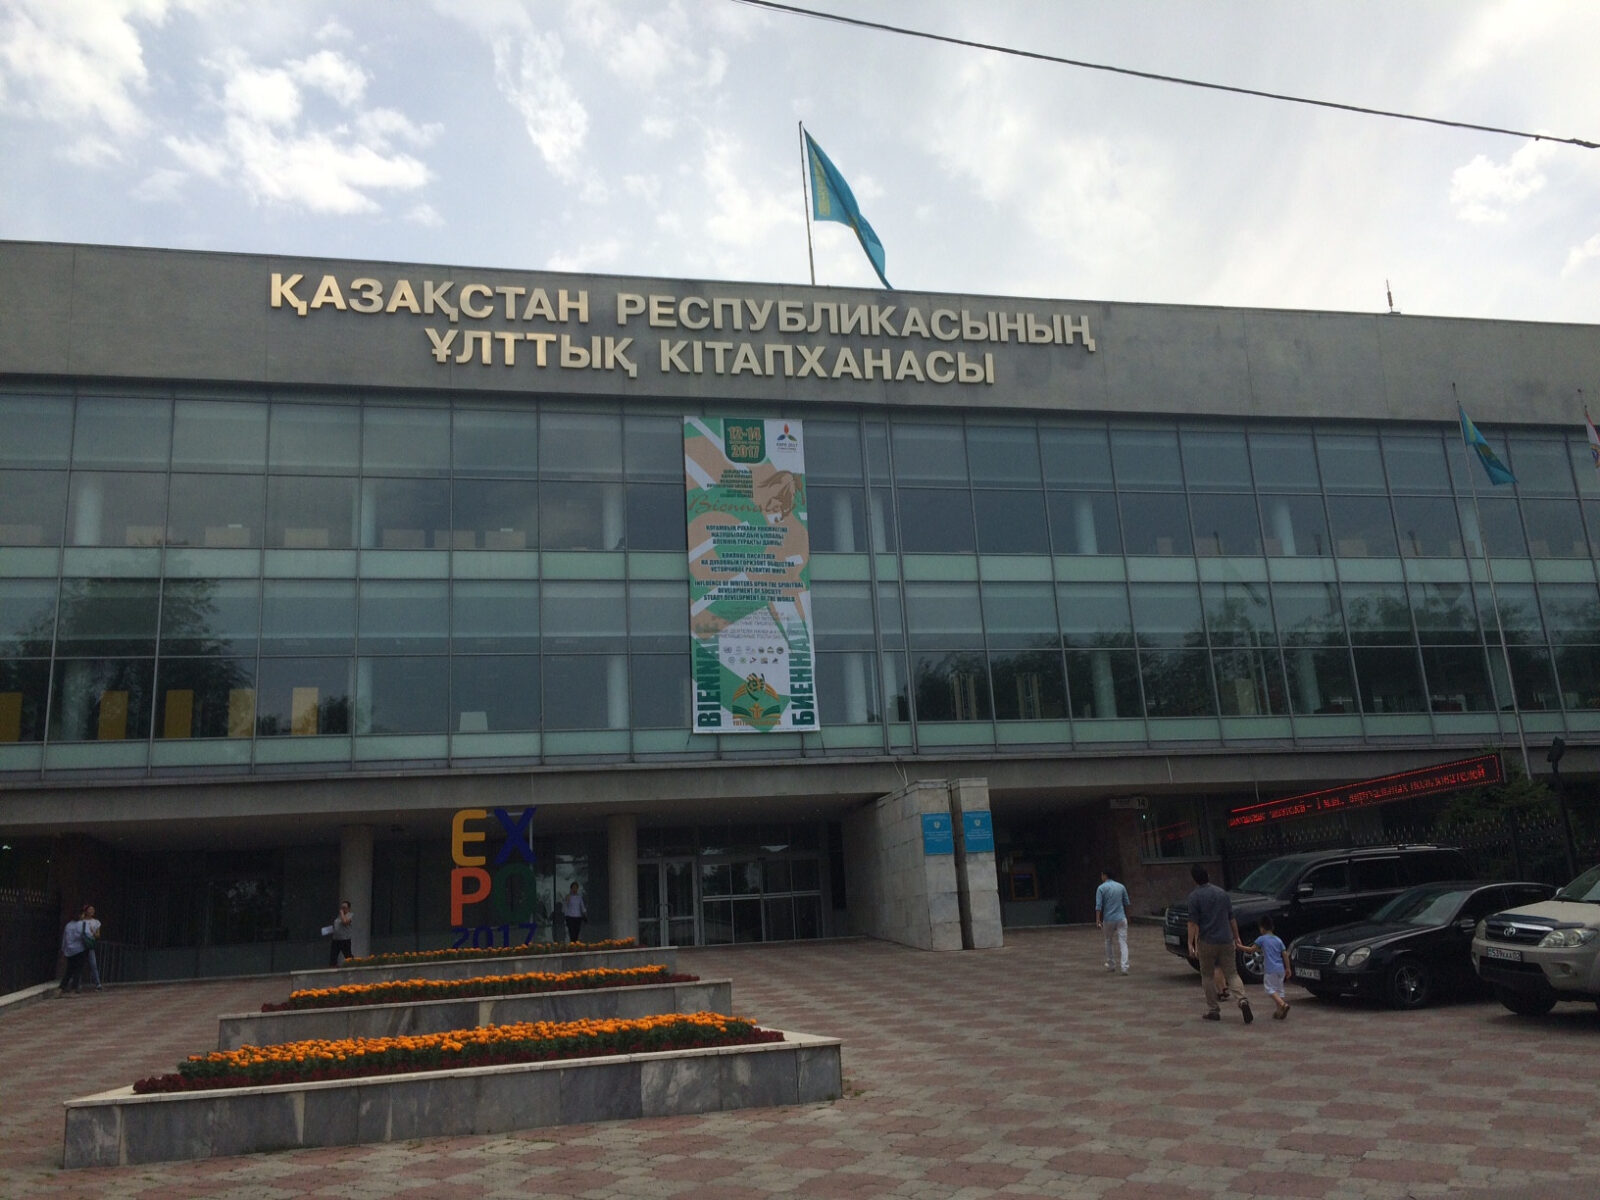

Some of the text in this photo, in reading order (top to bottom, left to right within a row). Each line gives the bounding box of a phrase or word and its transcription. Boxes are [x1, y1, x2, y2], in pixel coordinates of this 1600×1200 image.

[270, 273, 1096, 352] ҚАЗАҚСТАН РЕСПУБЛИКАСЫНЫҢ
[424, 328, 995, 386] ҰЛТТЫҚ КІТАПХАНАСЫ
[731, 445, 759, 458] 2017
[451, 923, 538, 950] 2017
